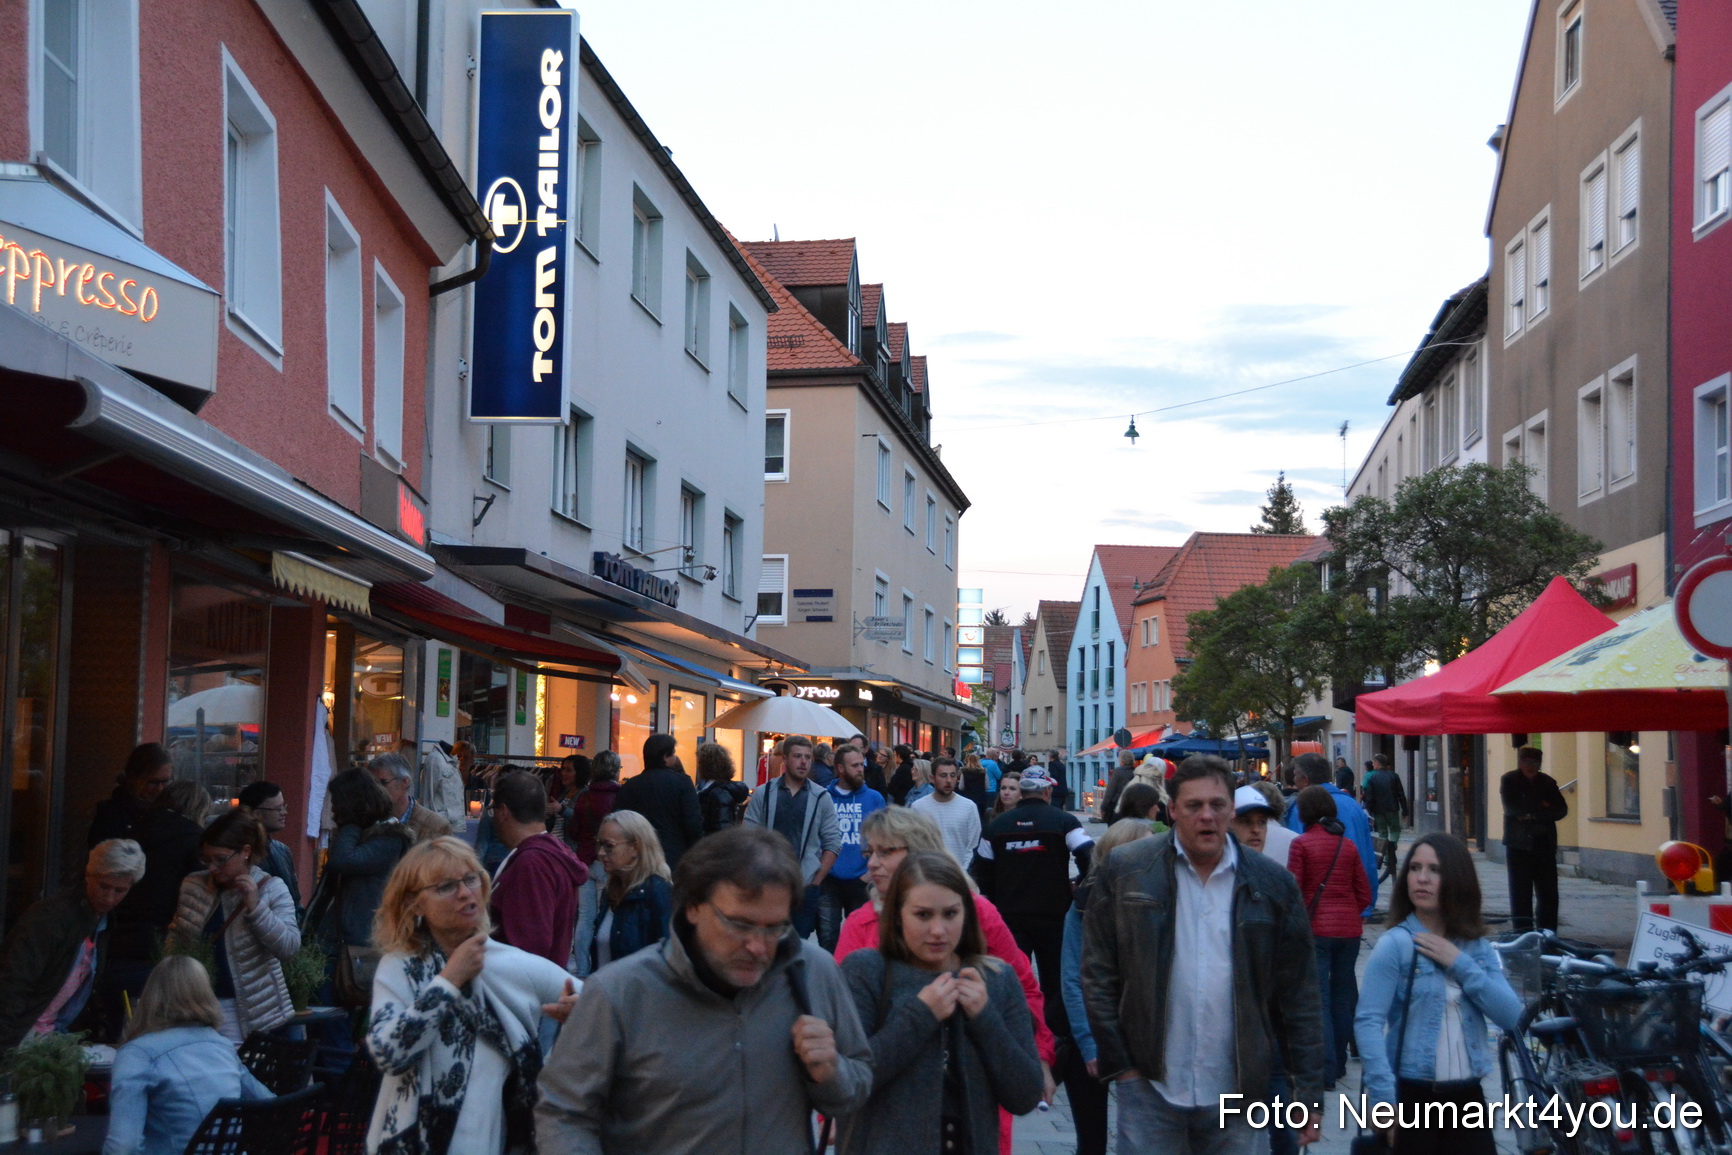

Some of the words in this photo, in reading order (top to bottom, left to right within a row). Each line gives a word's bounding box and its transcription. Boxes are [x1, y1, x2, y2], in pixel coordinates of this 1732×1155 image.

[537, 48, 564, 236] TAILOR
[532, 246, 556, 383] TOM
[594, 551, 634, 588] TOM
[634, 568, 680, 608] TAILOR
[564, 736, 580, 746] NEW
[838, 818, 862, 832] OT
[840, 832, 861, 845] AR
